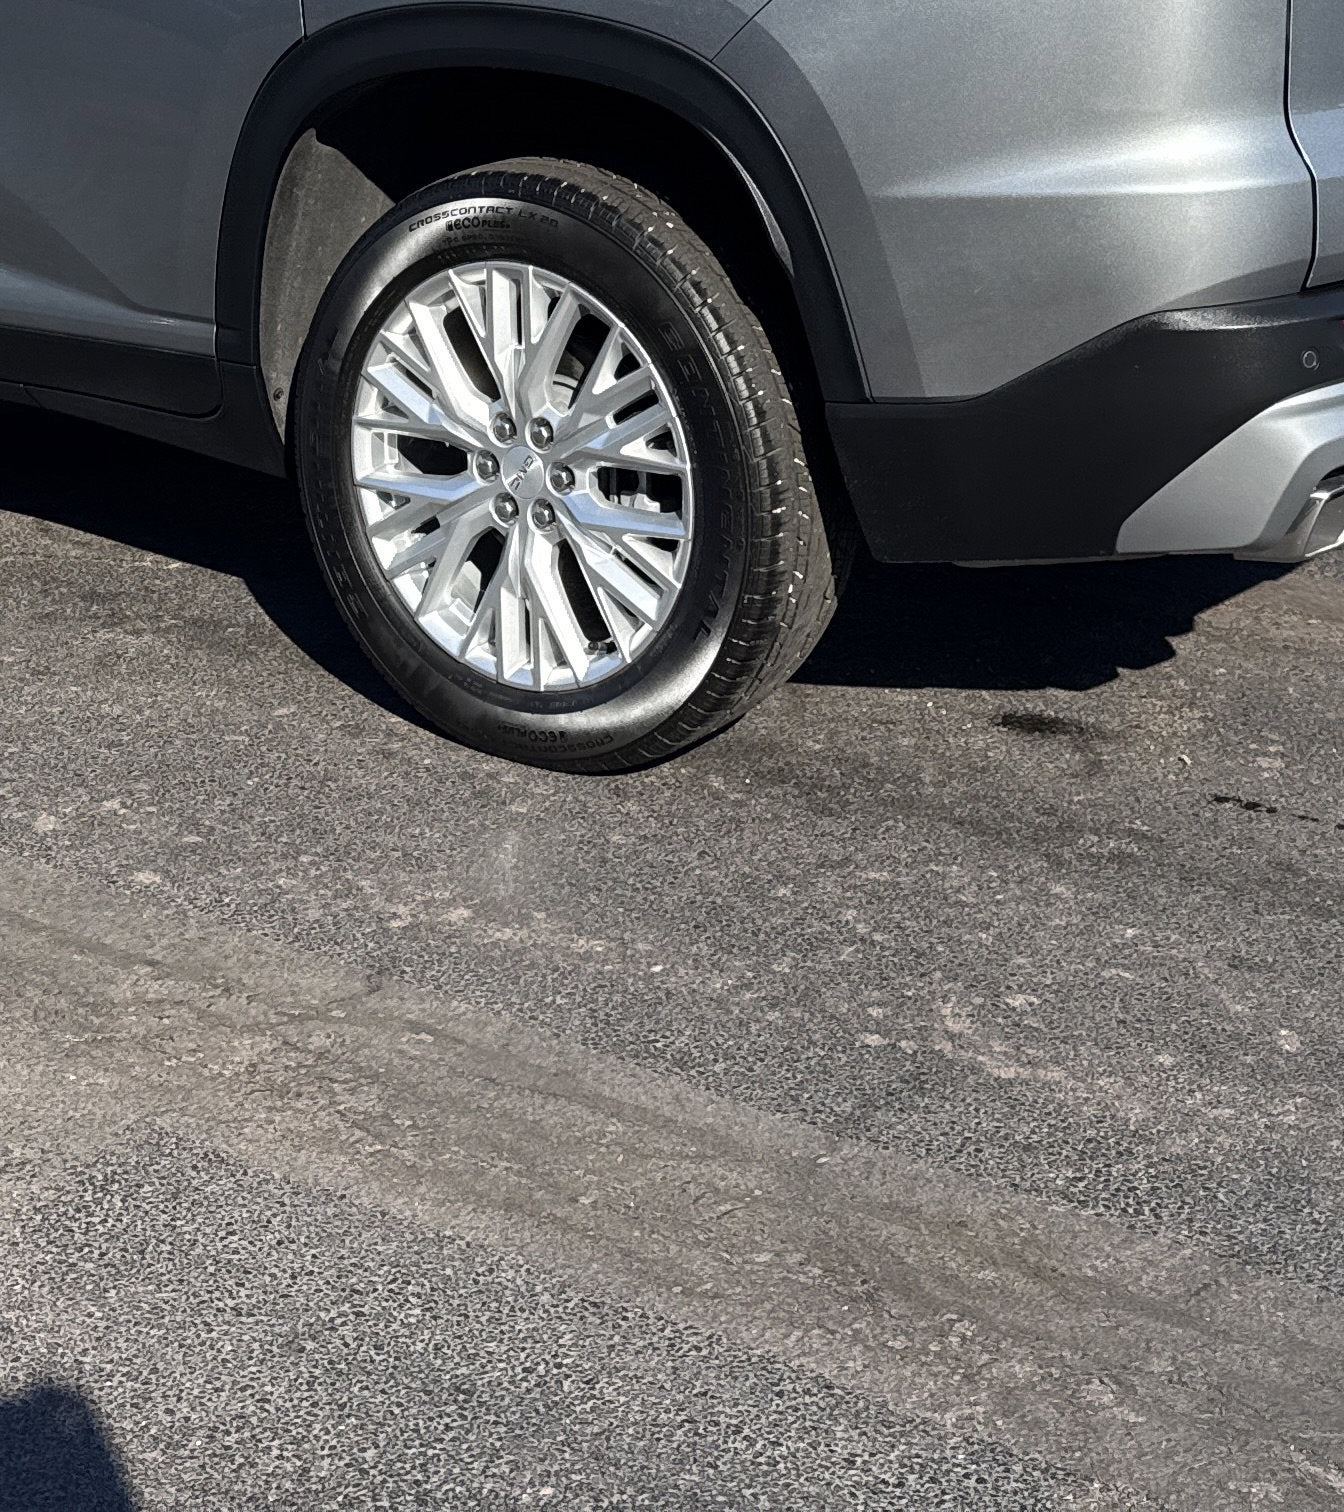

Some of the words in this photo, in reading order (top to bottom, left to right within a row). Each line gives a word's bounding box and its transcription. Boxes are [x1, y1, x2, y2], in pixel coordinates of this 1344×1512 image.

[408, 205, 514, 233] CROSSCONTACT
[517, 208, 538, 220] LX
[508, 454, 534, 491] GMC
